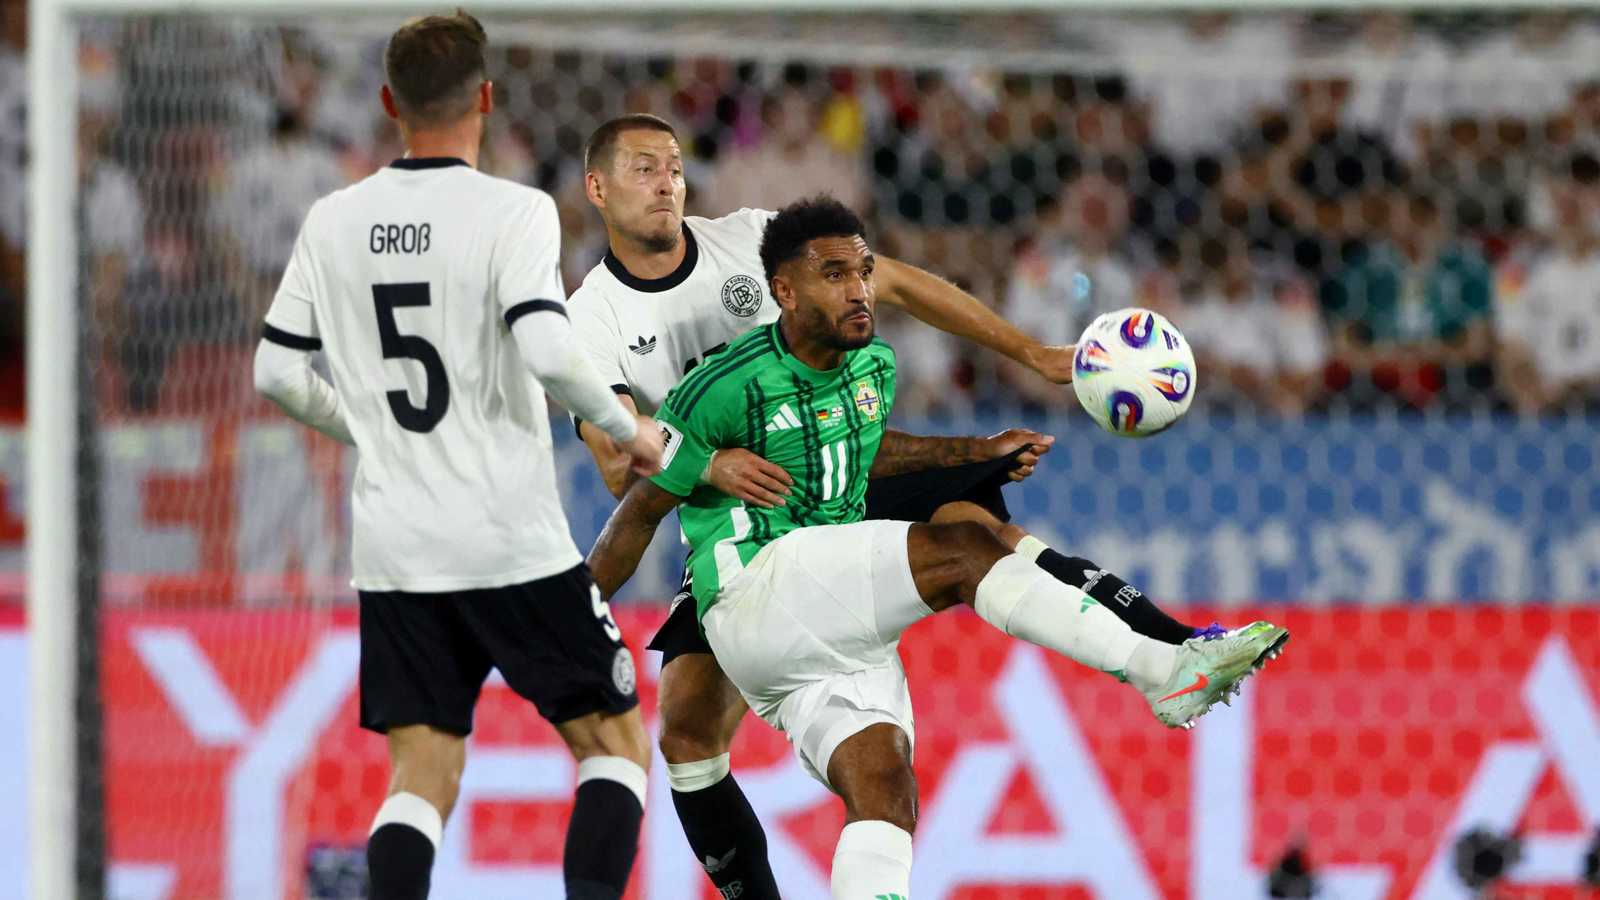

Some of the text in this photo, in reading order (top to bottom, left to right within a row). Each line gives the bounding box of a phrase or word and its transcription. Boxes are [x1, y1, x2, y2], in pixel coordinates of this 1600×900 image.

[369, 223, 431, 255] GROß
[371, 282, 450, 434] 5
[821, 440, 847, 501] 11
